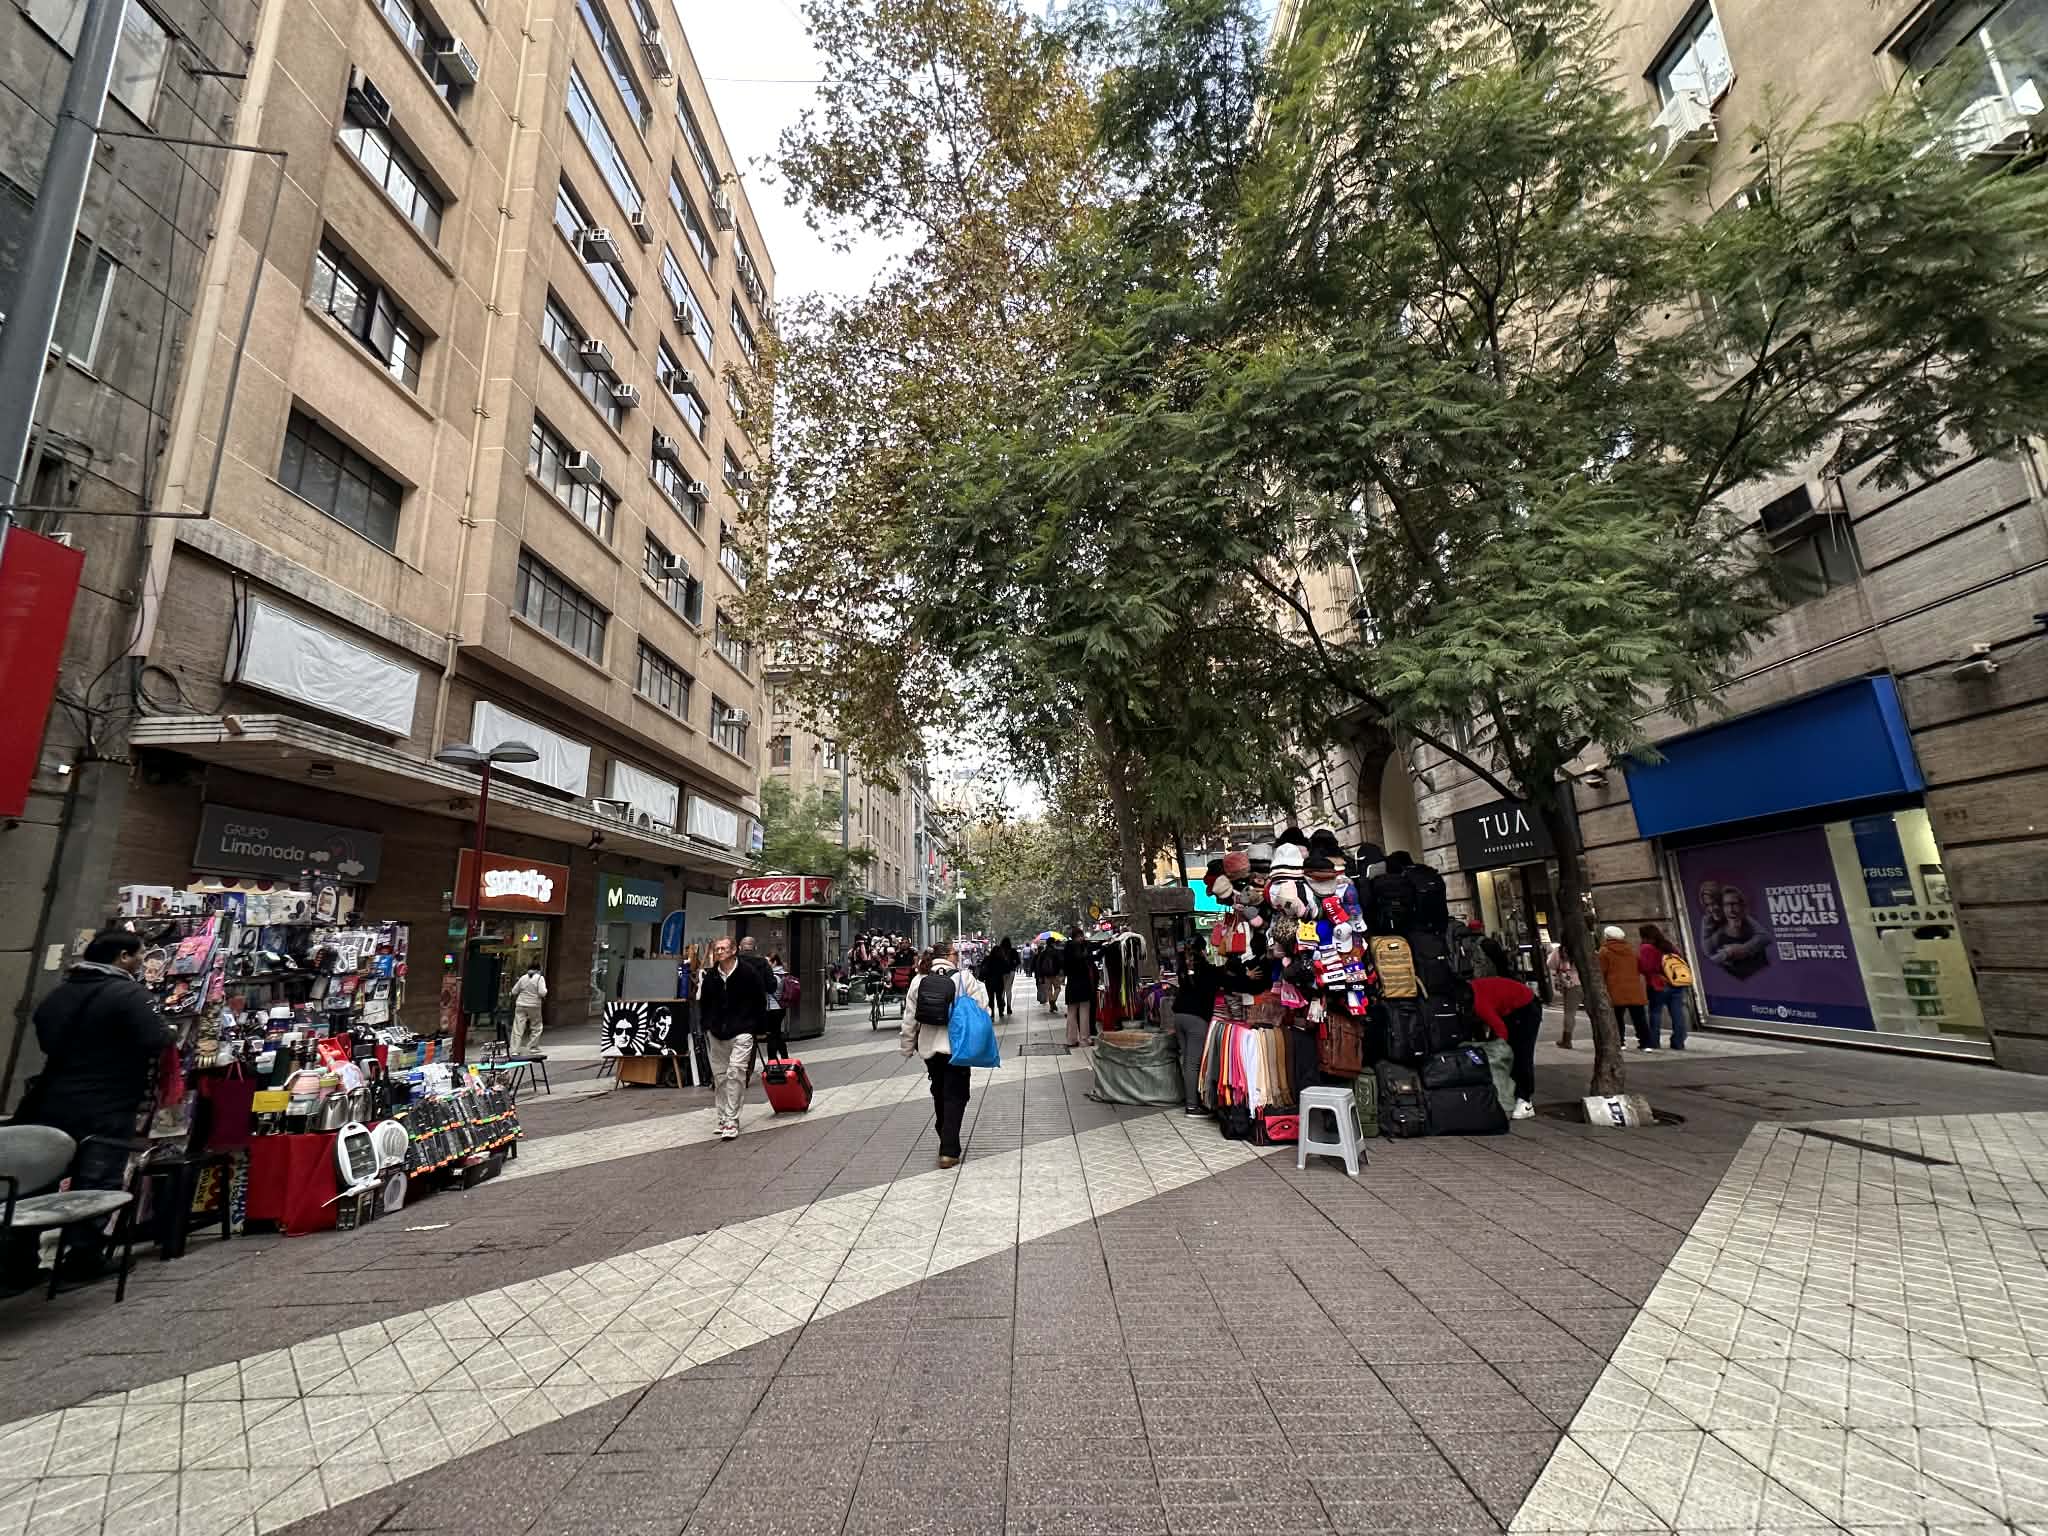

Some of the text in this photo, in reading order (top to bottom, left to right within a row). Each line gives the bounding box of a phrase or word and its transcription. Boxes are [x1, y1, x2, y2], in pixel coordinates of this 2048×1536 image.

[223, 823, 269, 839] GRUPO
[220, 836, 305, 861] Limonada
[736, 881, 799, 904] Coca-Cola
[1765, 882, 1832, 895] EXPERTOS EN
[625, 893, 659, 908] movistar
[1767, 893, 1836, 913] MULTI
[1770, 911, 1839, 926] FOCALES
